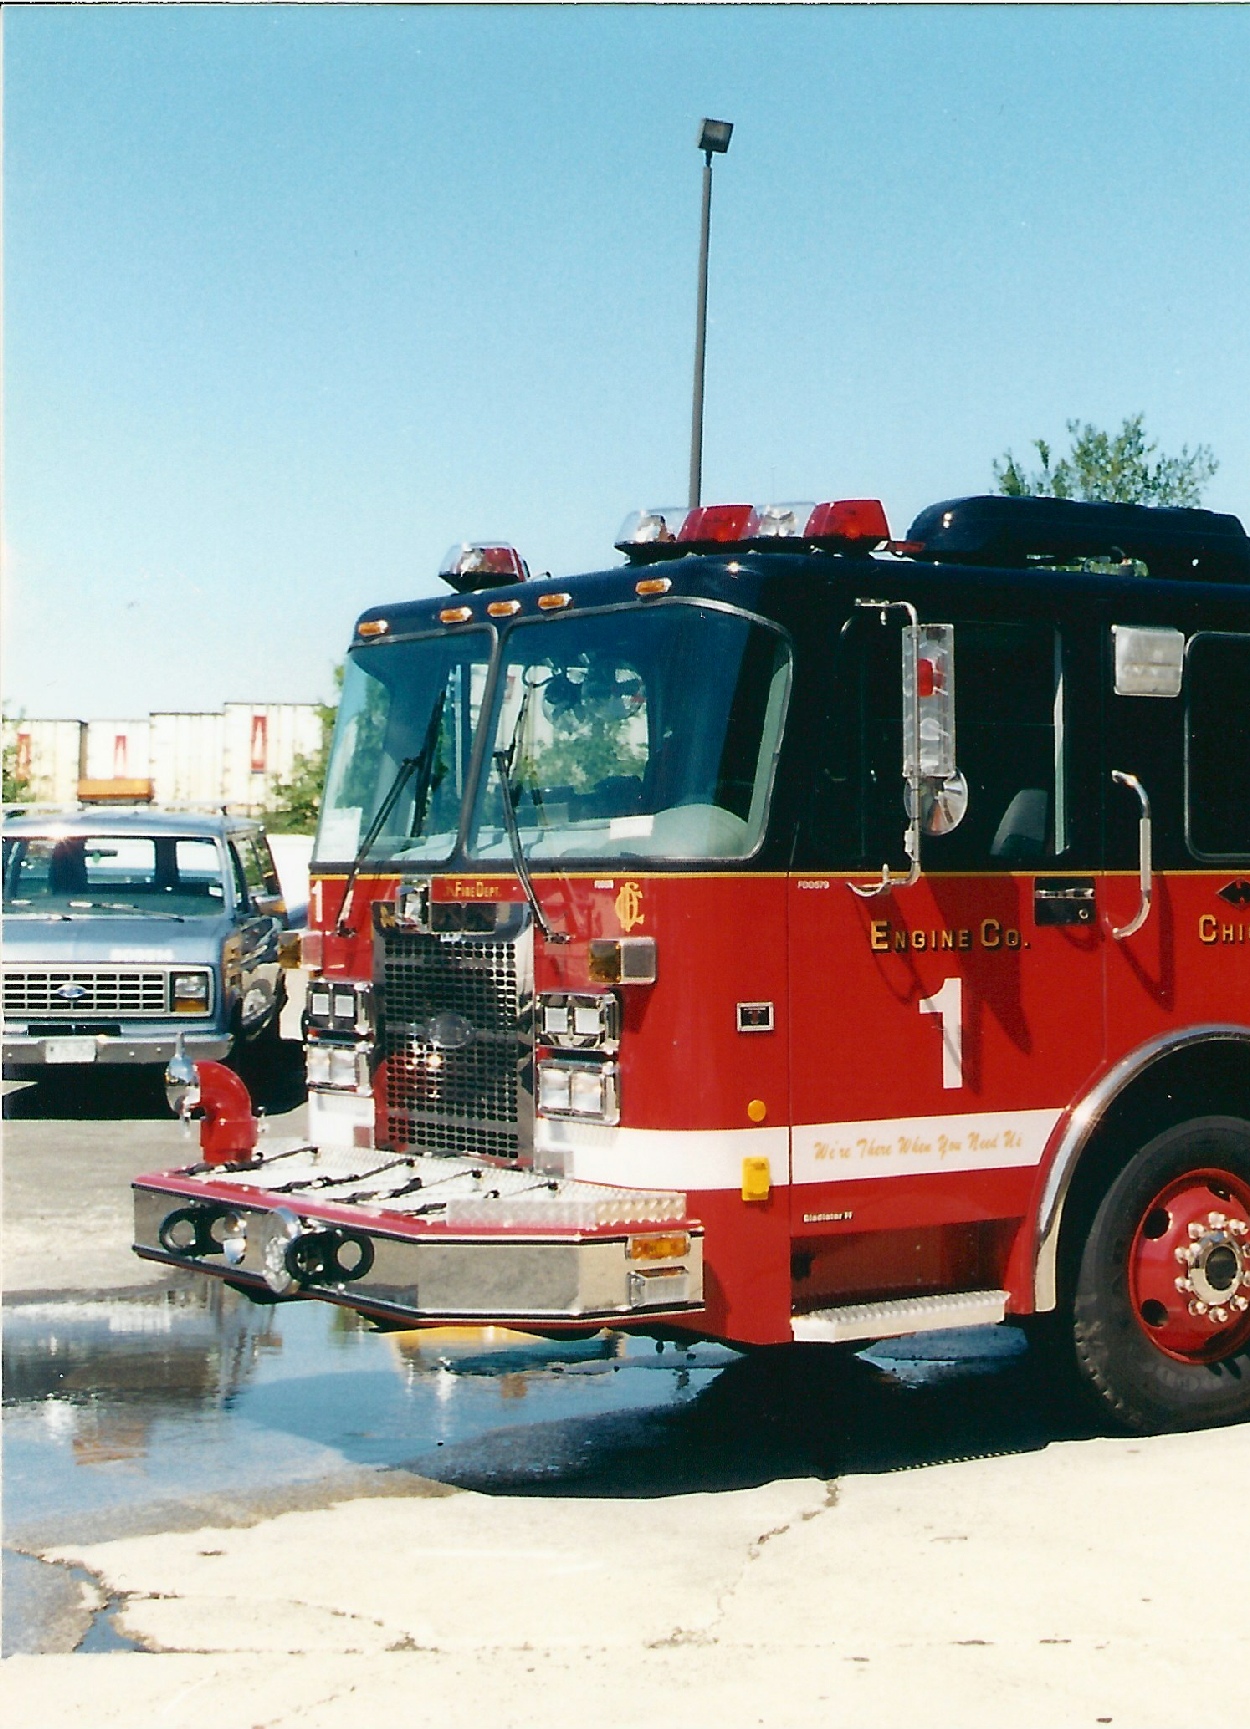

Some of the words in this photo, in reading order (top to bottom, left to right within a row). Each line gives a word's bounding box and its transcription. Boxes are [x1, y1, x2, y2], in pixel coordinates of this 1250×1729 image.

[311, 880, 323, 923] 1
[455, 881, 475, 898] FIRE
[870, 919, 973, 953] ENGINE
[980, 918, 1031, 951] CO.
[919, 977, 963, 1089] 1
[814, 1140, 851, 1160] We're
[856, 1137, 893, 1158] There
[898, 1135, 932, 1154] When
[937, 1133, 963, 1160] You
[967, 1130, 1000, 1151] Need
